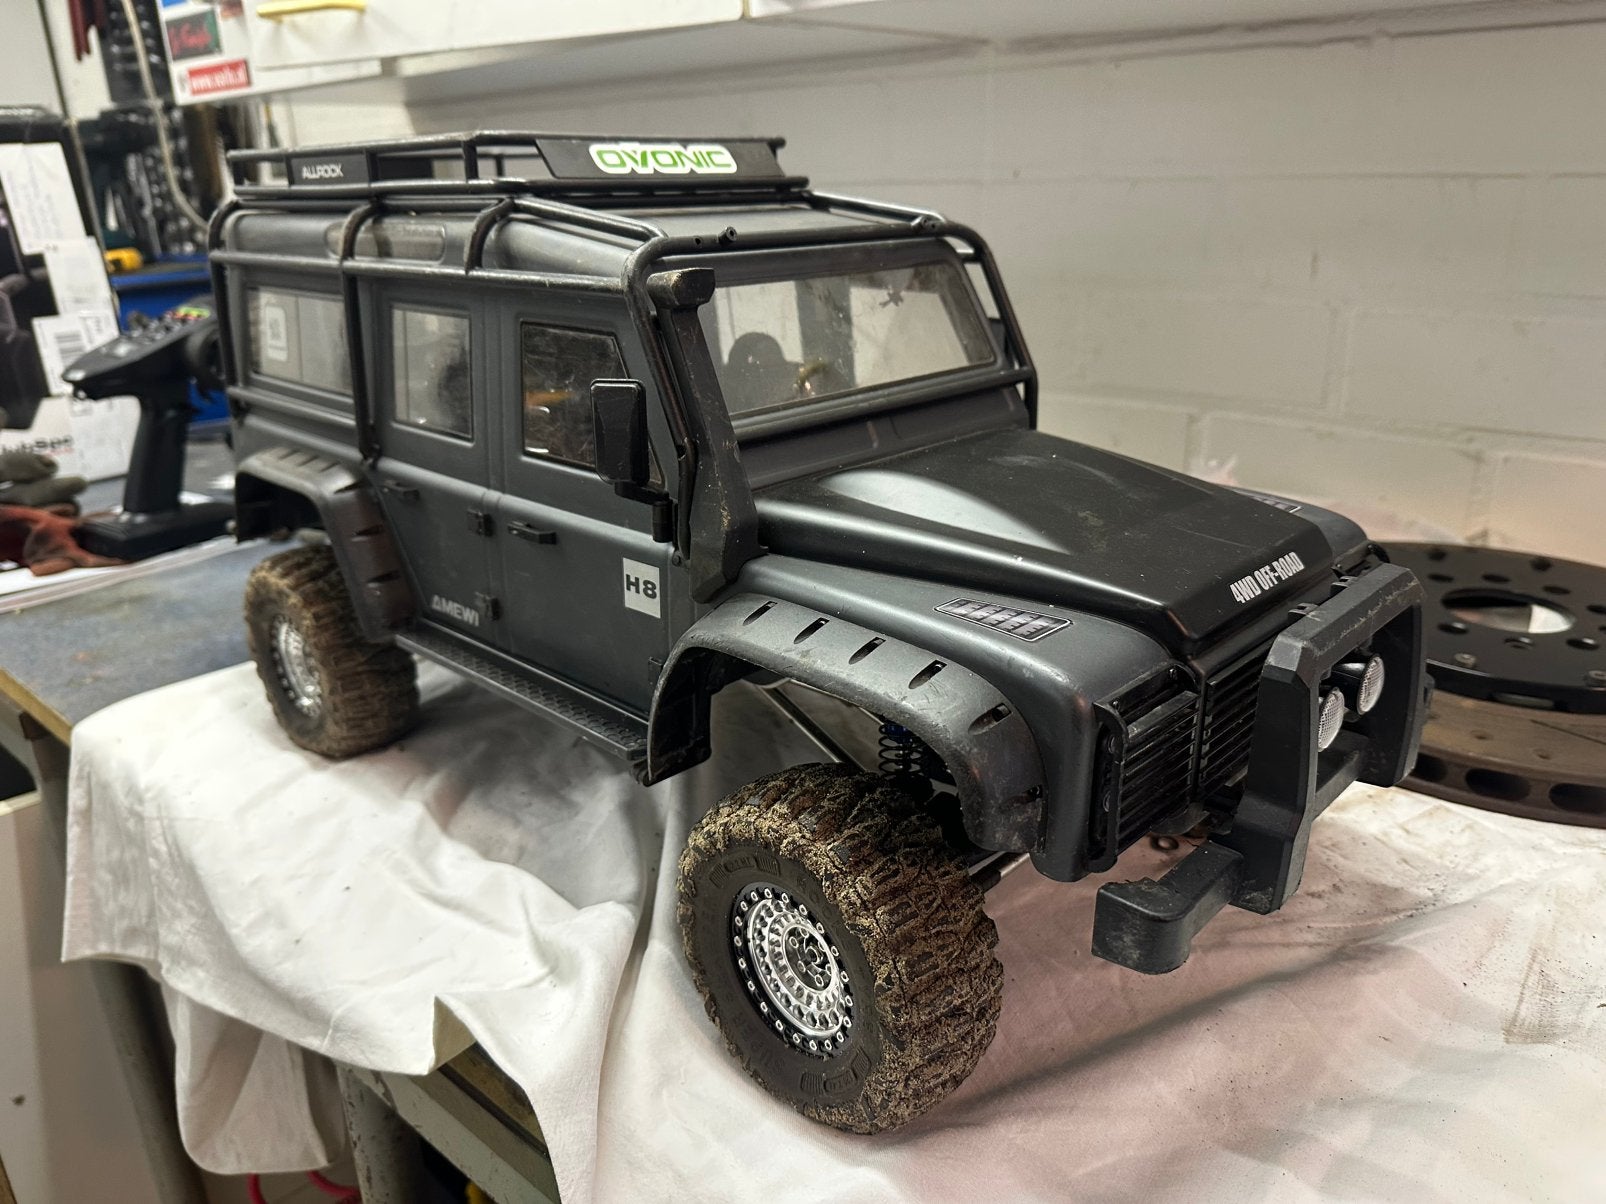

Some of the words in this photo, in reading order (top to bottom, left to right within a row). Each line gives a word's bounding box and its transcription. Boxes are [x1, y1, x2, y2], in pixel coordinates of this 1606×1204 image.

[594, 148, 734, 170] OVONIC
[626, 574, 657, 599] H8
[1229, 575, 1262, 604] 4WD
[1253, 551, 1305, 591] OFF-ROAD
[431, 594, 480, 627] AMEWI
